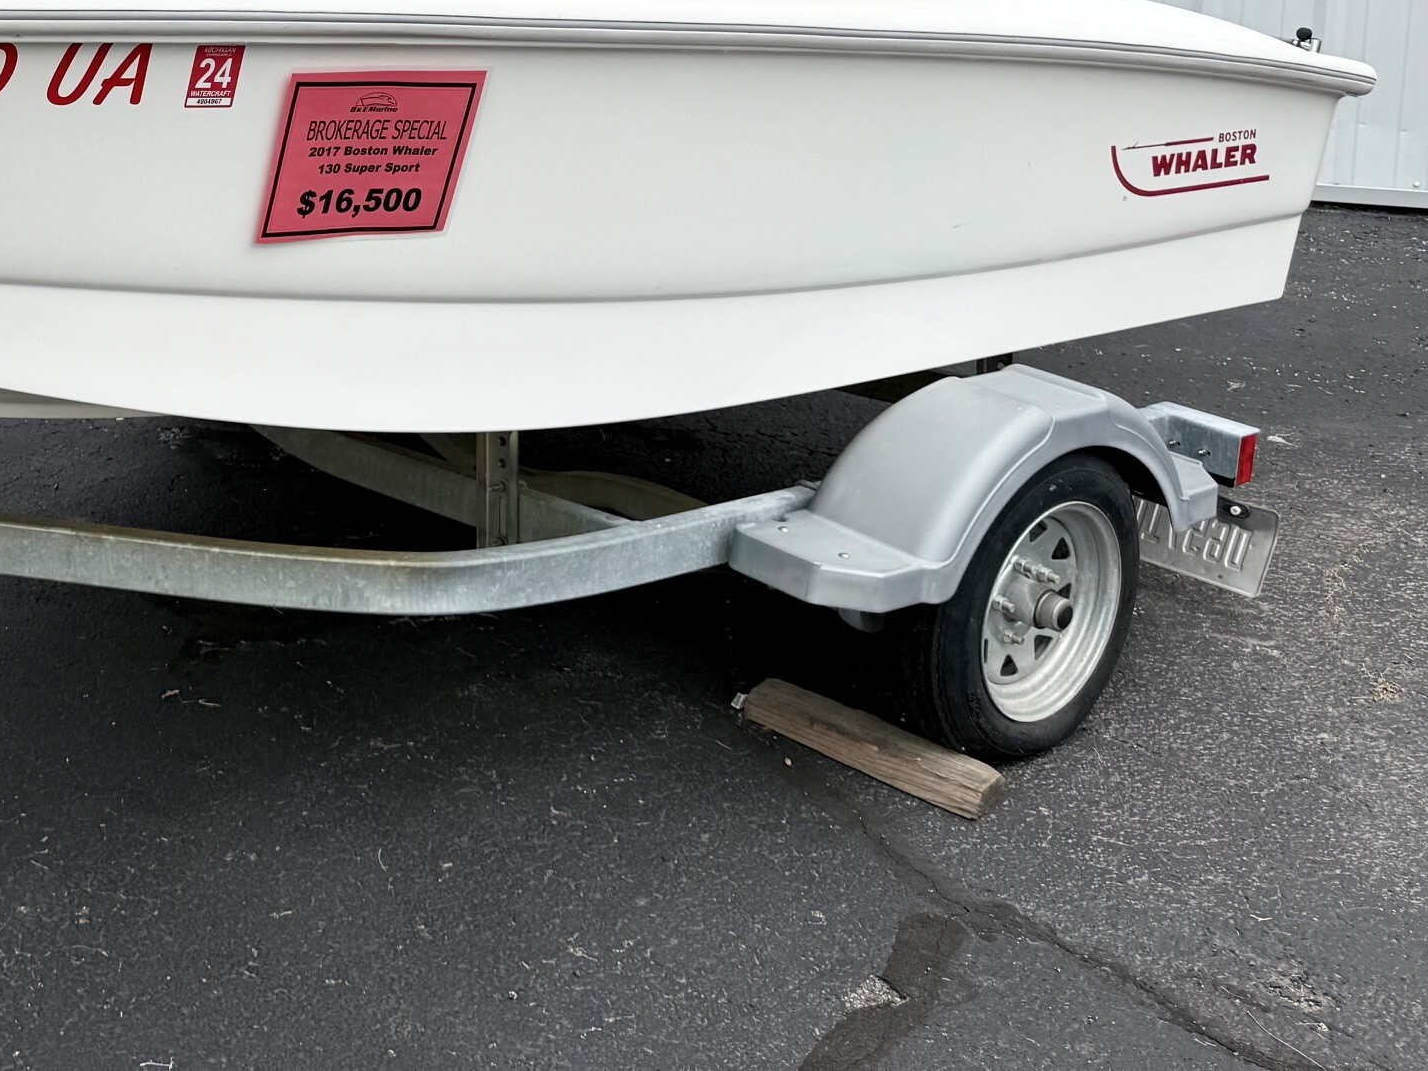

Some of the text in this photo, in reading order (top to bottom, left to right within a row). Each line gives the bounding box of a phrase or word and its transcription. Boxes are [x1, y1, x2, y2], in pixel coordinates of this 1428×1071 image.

[45, 42, 154, 107] UA
[194, 57, 233, 89] 24
[306, 119, 448, 141] BROKERAGE SPECIAL
[1218, 128, 1257, 143] BOSTON
[308, 145, 439, 157] 2017 Boston Whaler
[1151, 143, 1258, 177] WHALER
[318, 162, 421, 175] 130 Super Sport
[296, 187, 423, 219] $16,500
